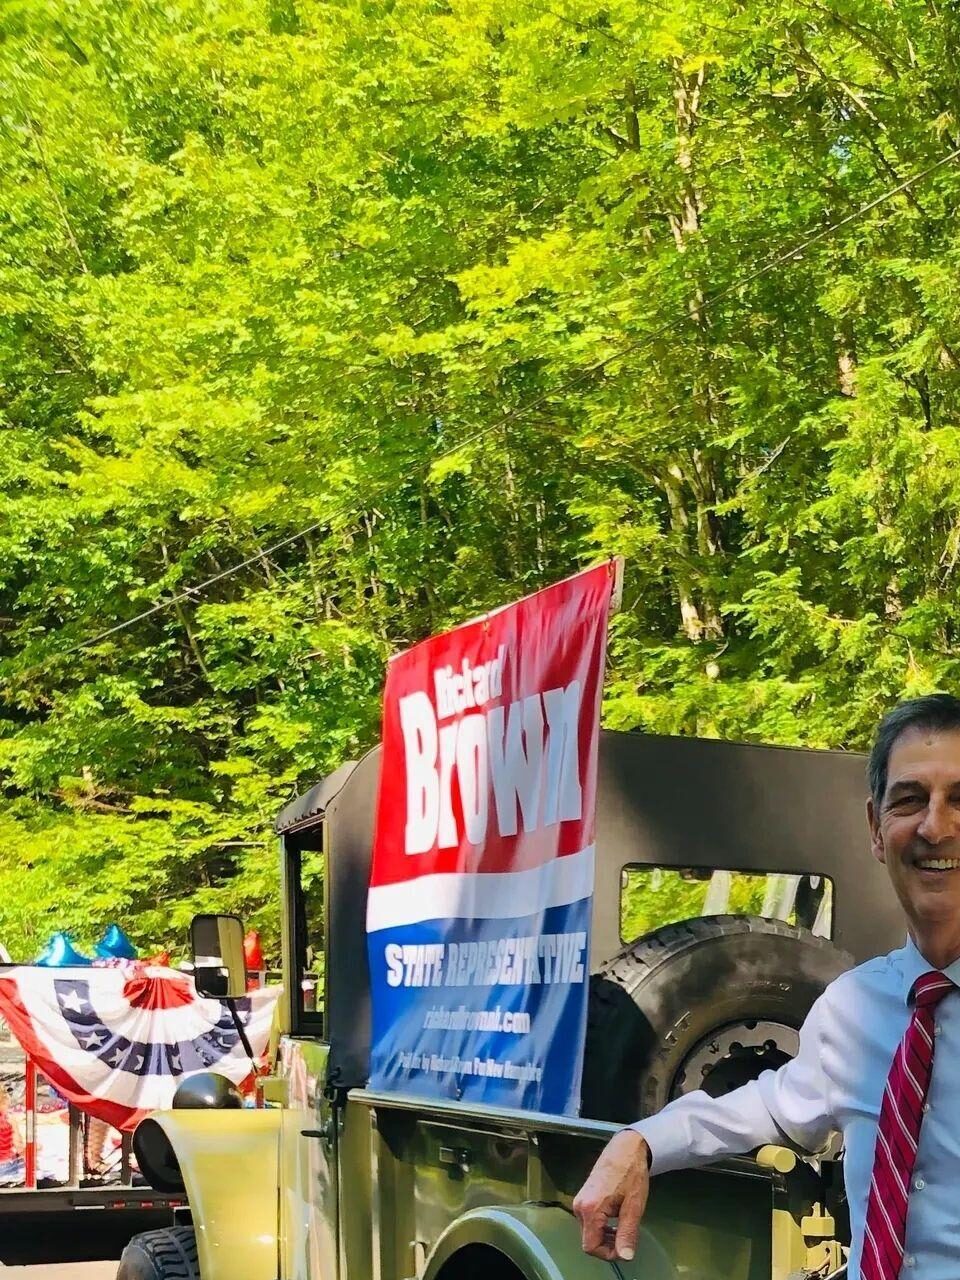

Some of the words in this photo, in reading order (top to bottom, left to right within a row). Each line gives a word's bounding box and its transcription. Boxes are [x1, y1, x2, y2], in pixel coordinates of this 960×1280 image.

[434, 645, 505, 719] Richard
[400, 680, 582, 855] Brown
[385, 943, 445, 987] STATE
[445, 932, 586, 986] REPRESENTATIVE
